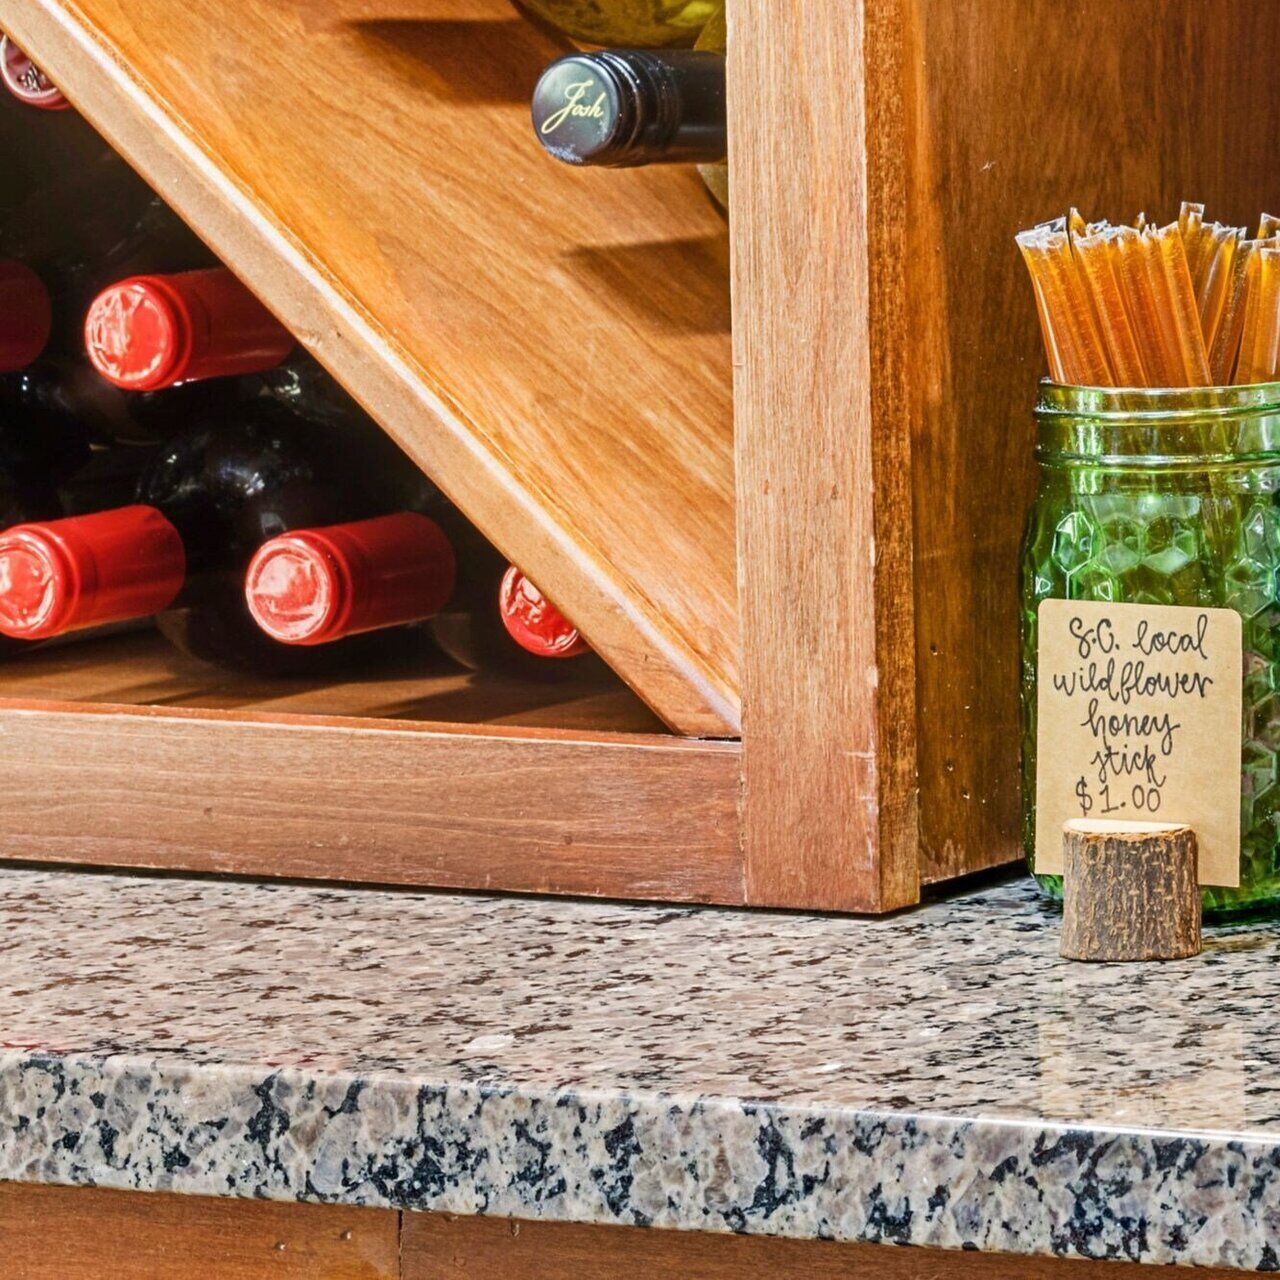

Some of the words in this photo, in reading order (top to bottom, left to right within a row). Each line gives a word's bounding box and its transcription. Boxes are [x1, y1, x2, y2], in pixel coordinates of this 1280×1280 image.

[541, 79, 605, 134] Josh
[1133, 614, 1208, 660] local
[1053, 657, 1214, 704] wildflower
[1081, 698, 1180, 755] honey
[1091, 744, 1166, 788] stick
